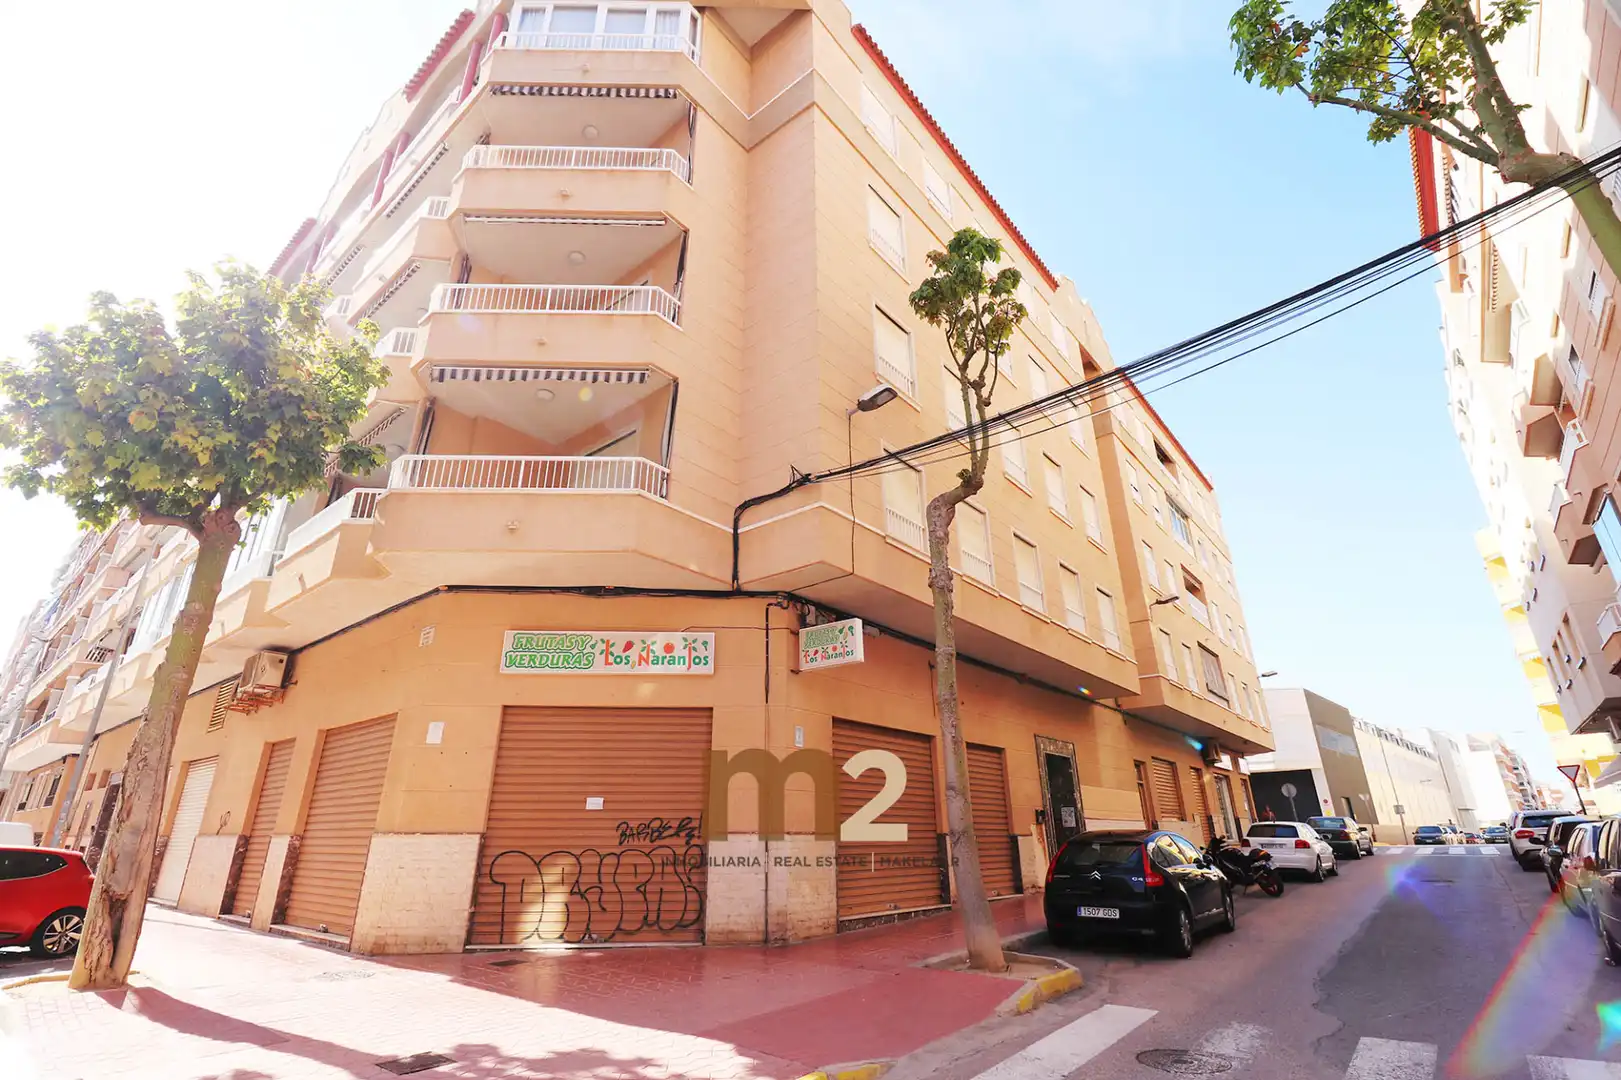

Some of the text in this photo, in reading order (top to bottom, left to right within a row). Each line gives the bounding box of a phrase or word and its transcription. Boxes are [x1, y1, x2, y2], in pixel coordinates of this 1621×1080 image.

[512, 633, 579, 650] FRUTAS
[504, 651, 595, 669] VERDURAS
[604, 639, 709, 670] Los Naranjos
[1083, 907, 1118, 918] 1507 GDS
